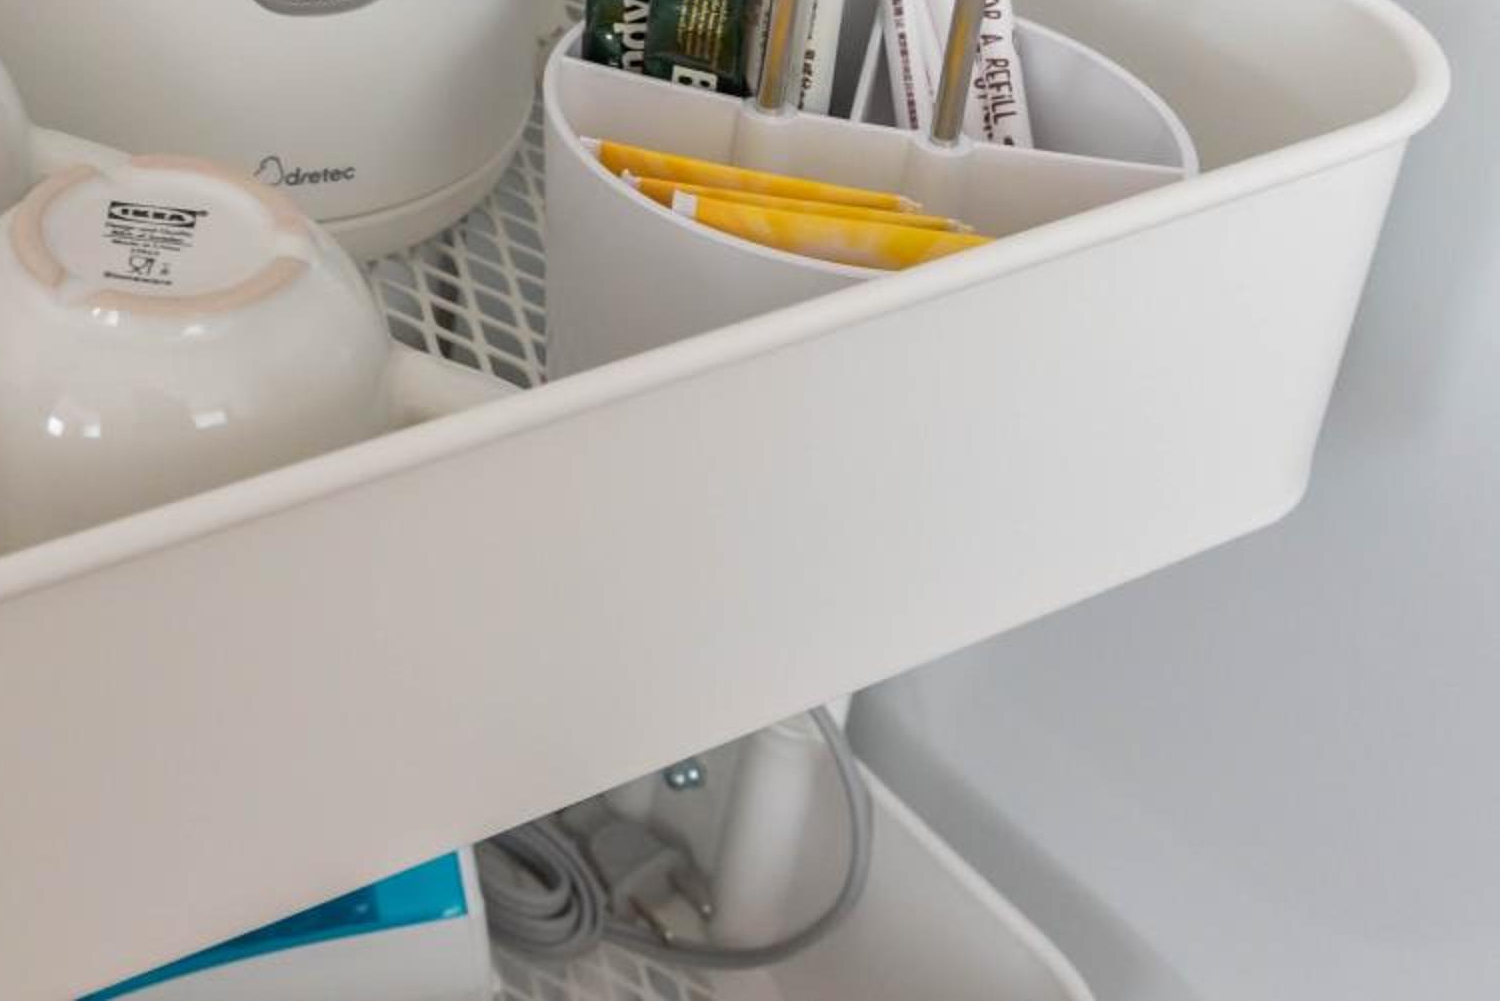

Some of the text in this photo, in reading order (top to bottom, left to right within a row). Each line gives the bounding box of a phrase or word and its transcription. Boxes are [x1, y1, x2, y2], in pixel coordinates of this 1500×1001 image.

[980, 34, 1003, 47] A
[985, 58, 1017, 126] REFILL
[285, 166, 356, 186] dretec
